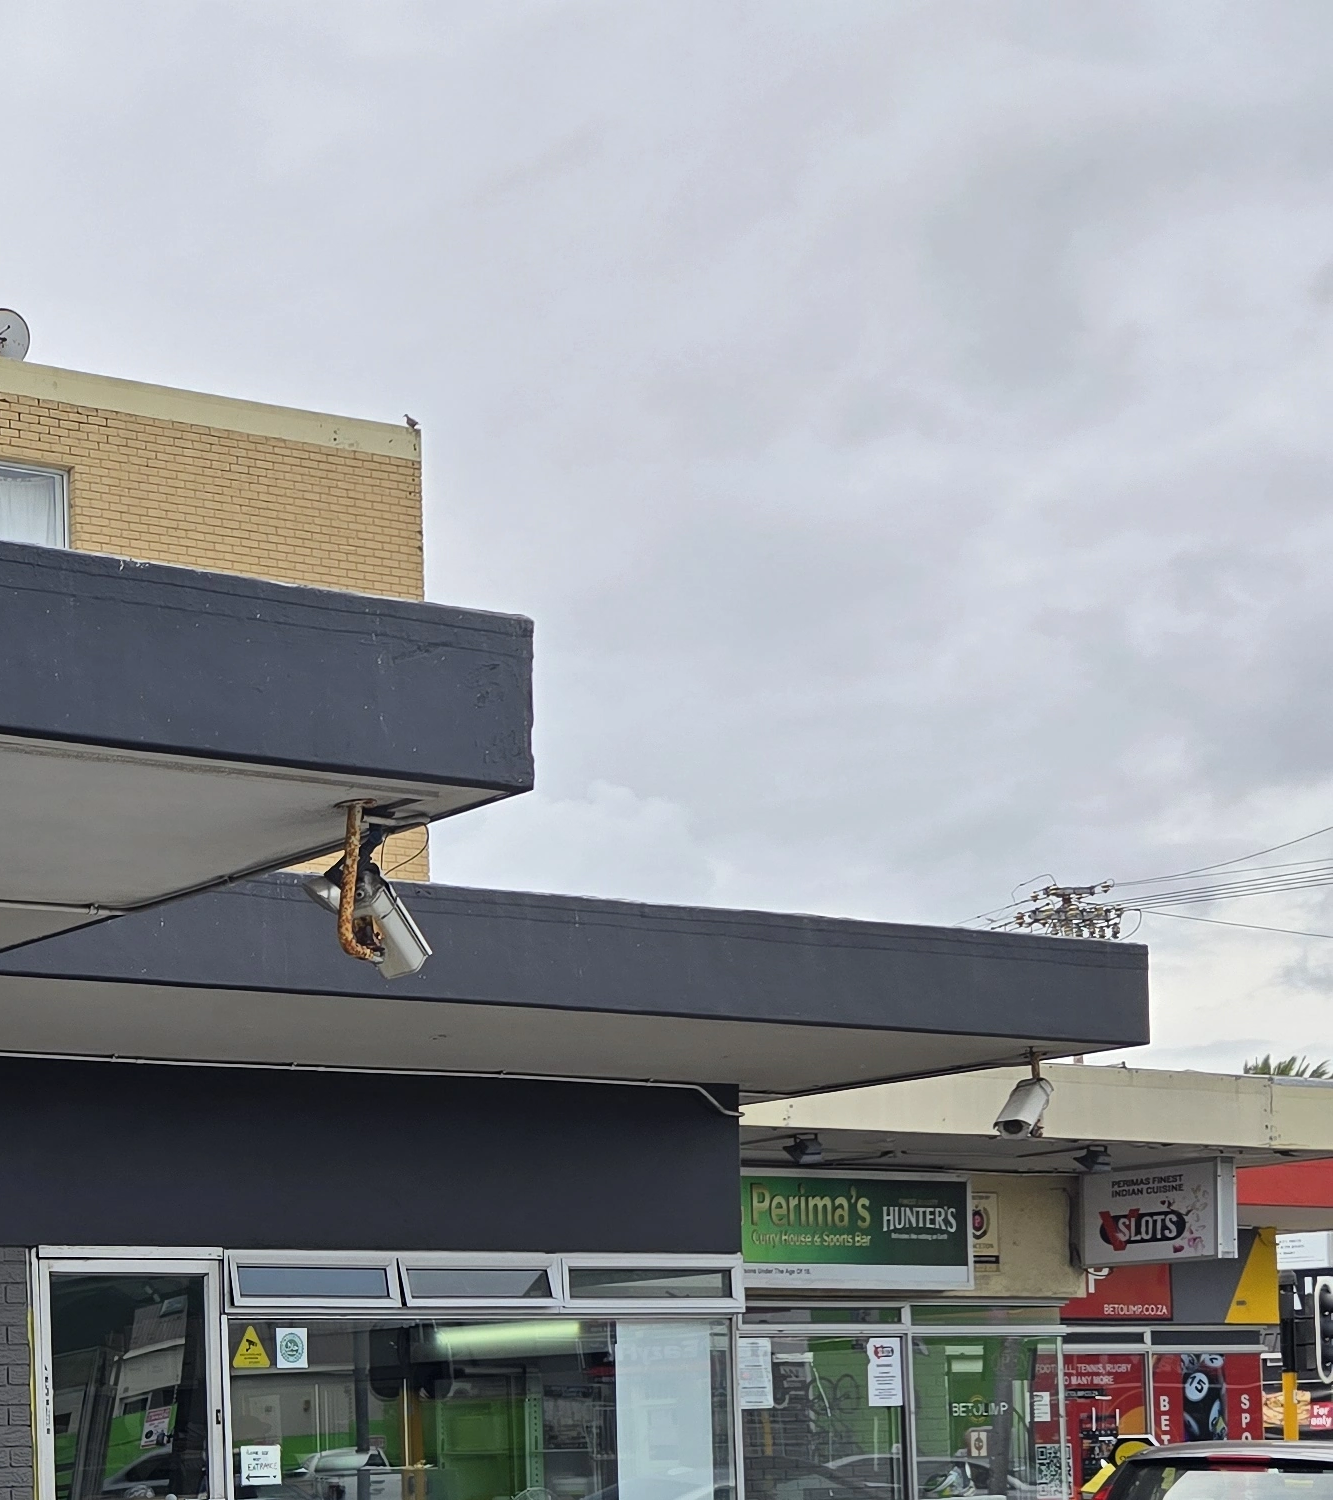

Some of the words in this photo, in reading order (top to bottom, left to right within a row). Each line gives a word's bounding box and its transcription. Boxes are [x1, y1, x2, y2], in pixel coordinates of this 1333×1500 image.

[1111, 1177, 1150, 1189] PERIMAS
[1151, 1174, 1183, 1185] FINEST
[1111, 1187, 1144, 1198] INDIAN
[1145, 1183, 1185, 1195] CUISINE
[750, 1182, 871, 1229] Perima's
[882, 1206, 958, 1233] HUNTER'S
[1117, 1214, 1179, 1242] SLOTS
[752, 1229, 780, 1249] Curry
[782, 1231, 812, 1246] House
[813, 1233, 821, 1246] &
[823, 1232, 853, 1247] Sports
[854, 1232, 872, 1247] Bar
[1103, 1304, 1169, 1316] BETOLIMP.CO.ZA
[1106, 1363, 1132, 1373] RUGBY
[1071, 1376, 1092, 1385] MANY
[1092, 1376, 1115, 1385] MORE
[1313, 1404, 1330, 1416] For
[1310, 1414, 1332, 1427] only
